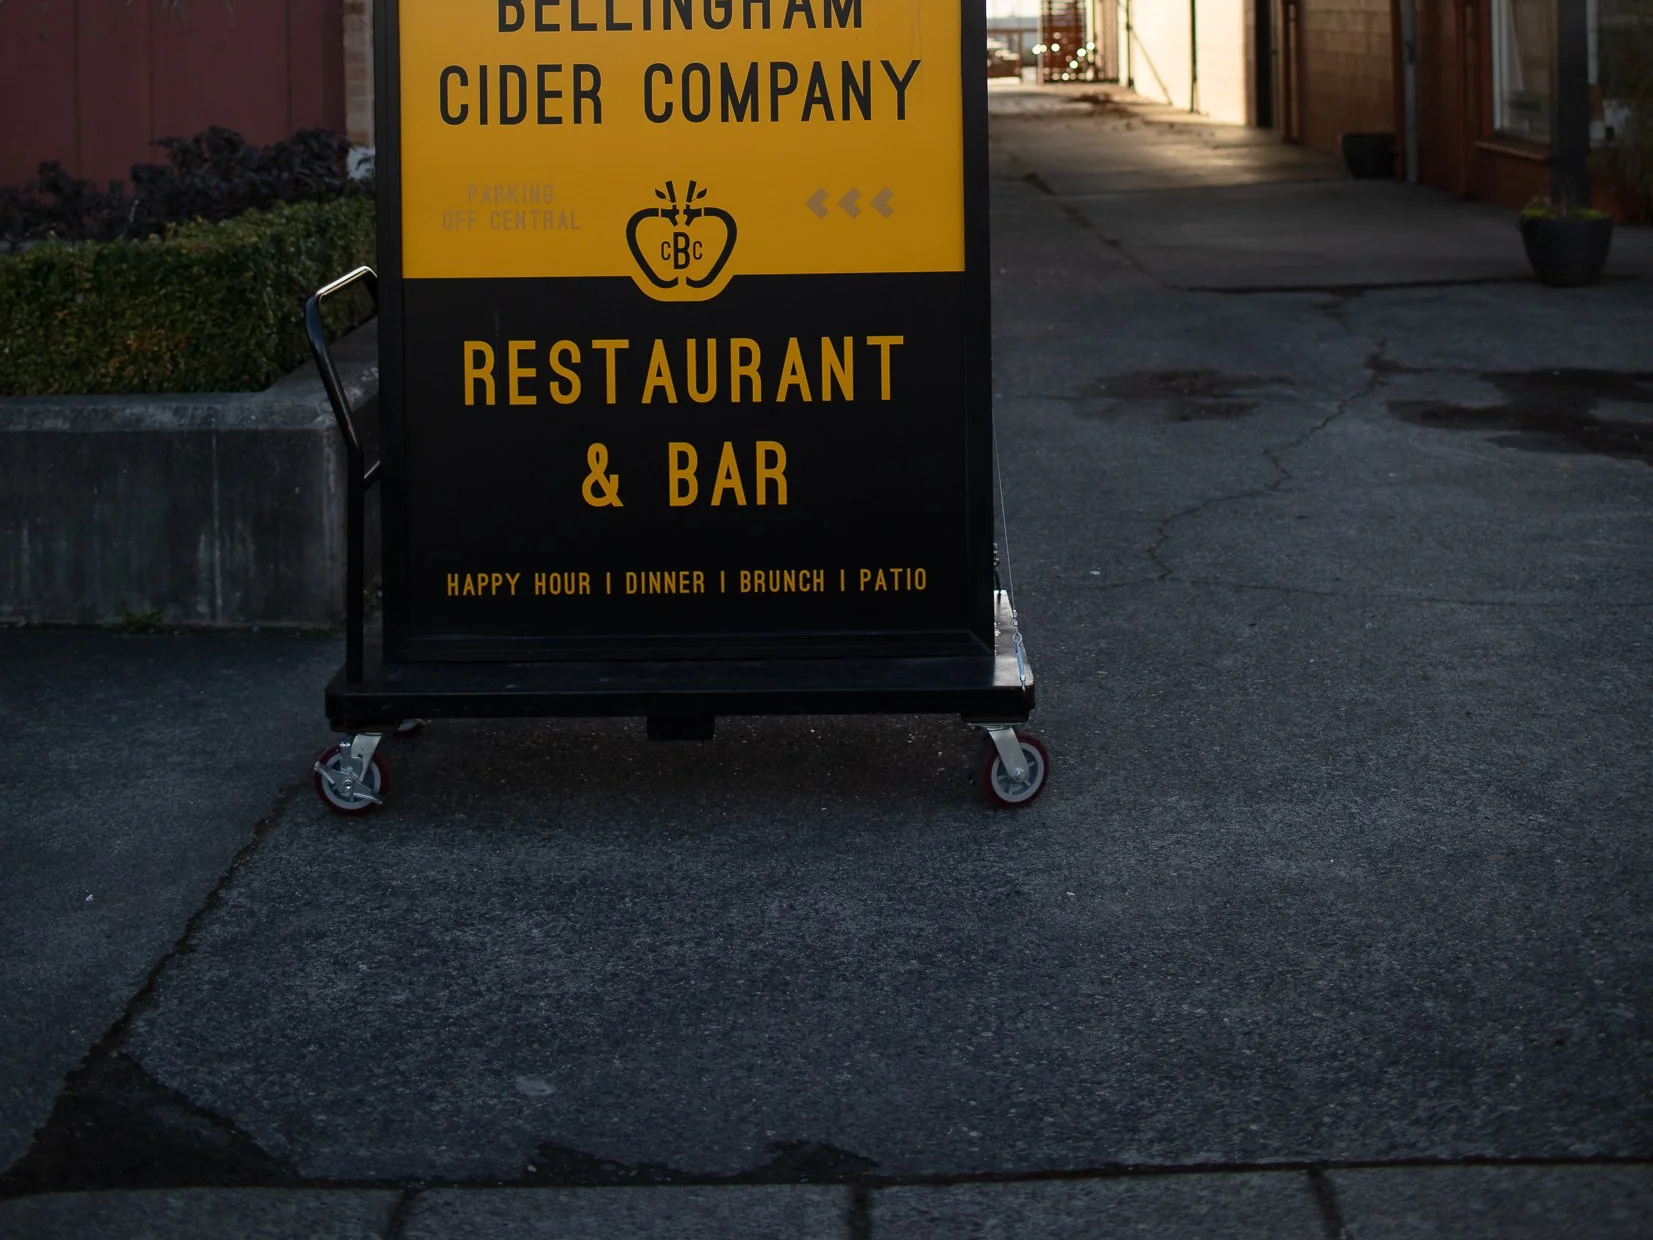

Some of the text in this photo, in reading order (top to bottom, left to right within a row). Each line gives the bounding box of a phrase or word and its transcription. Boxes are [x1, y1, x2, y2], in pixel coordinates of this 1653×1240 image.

[440, 59, 922, 126] CIDER COMPANY
[467, 183, 555, 205] PARKING
[442, 209, 581, 231] OFF CENTRAL
[463, 336, 904, 406] RESTAURANT
[582, 441, 788, 508] & BAR
[447, 572, 521, 596] HAPPY
[534, 572, 591, 596] HOUR
[625, 570, 705, 595] DINNER
[740, 569, 825, 594] BRUNCH
[859, 567, 927, 592] PATIO
